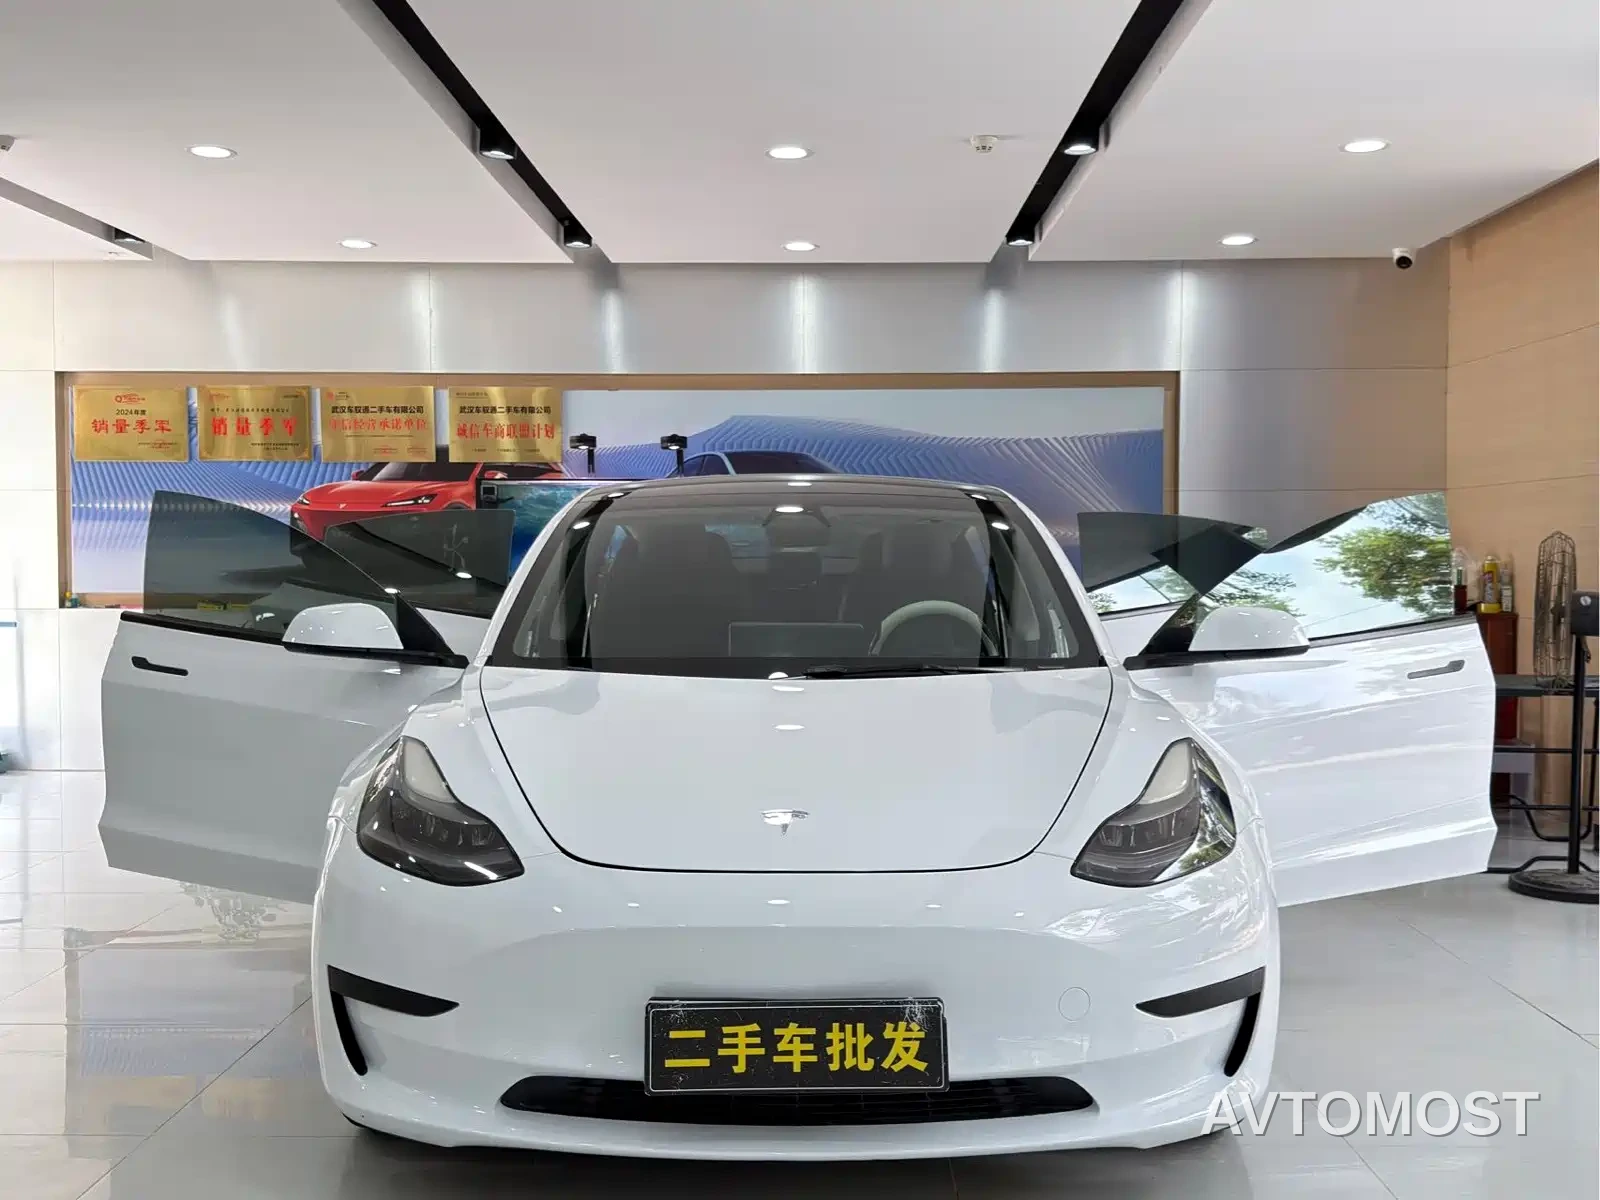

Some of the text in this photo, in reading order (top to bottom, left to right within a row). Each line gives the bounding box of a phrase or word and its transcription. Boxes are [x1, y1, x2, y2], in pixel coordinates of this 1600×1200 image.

[91, 418, 172, 434] 销量季军
[212, 416, 297, 437] 销量季军
[457, 422, 555, 439] 诚信车商联盟计划
[664, 1021, 929, 1073] 二手车批发
